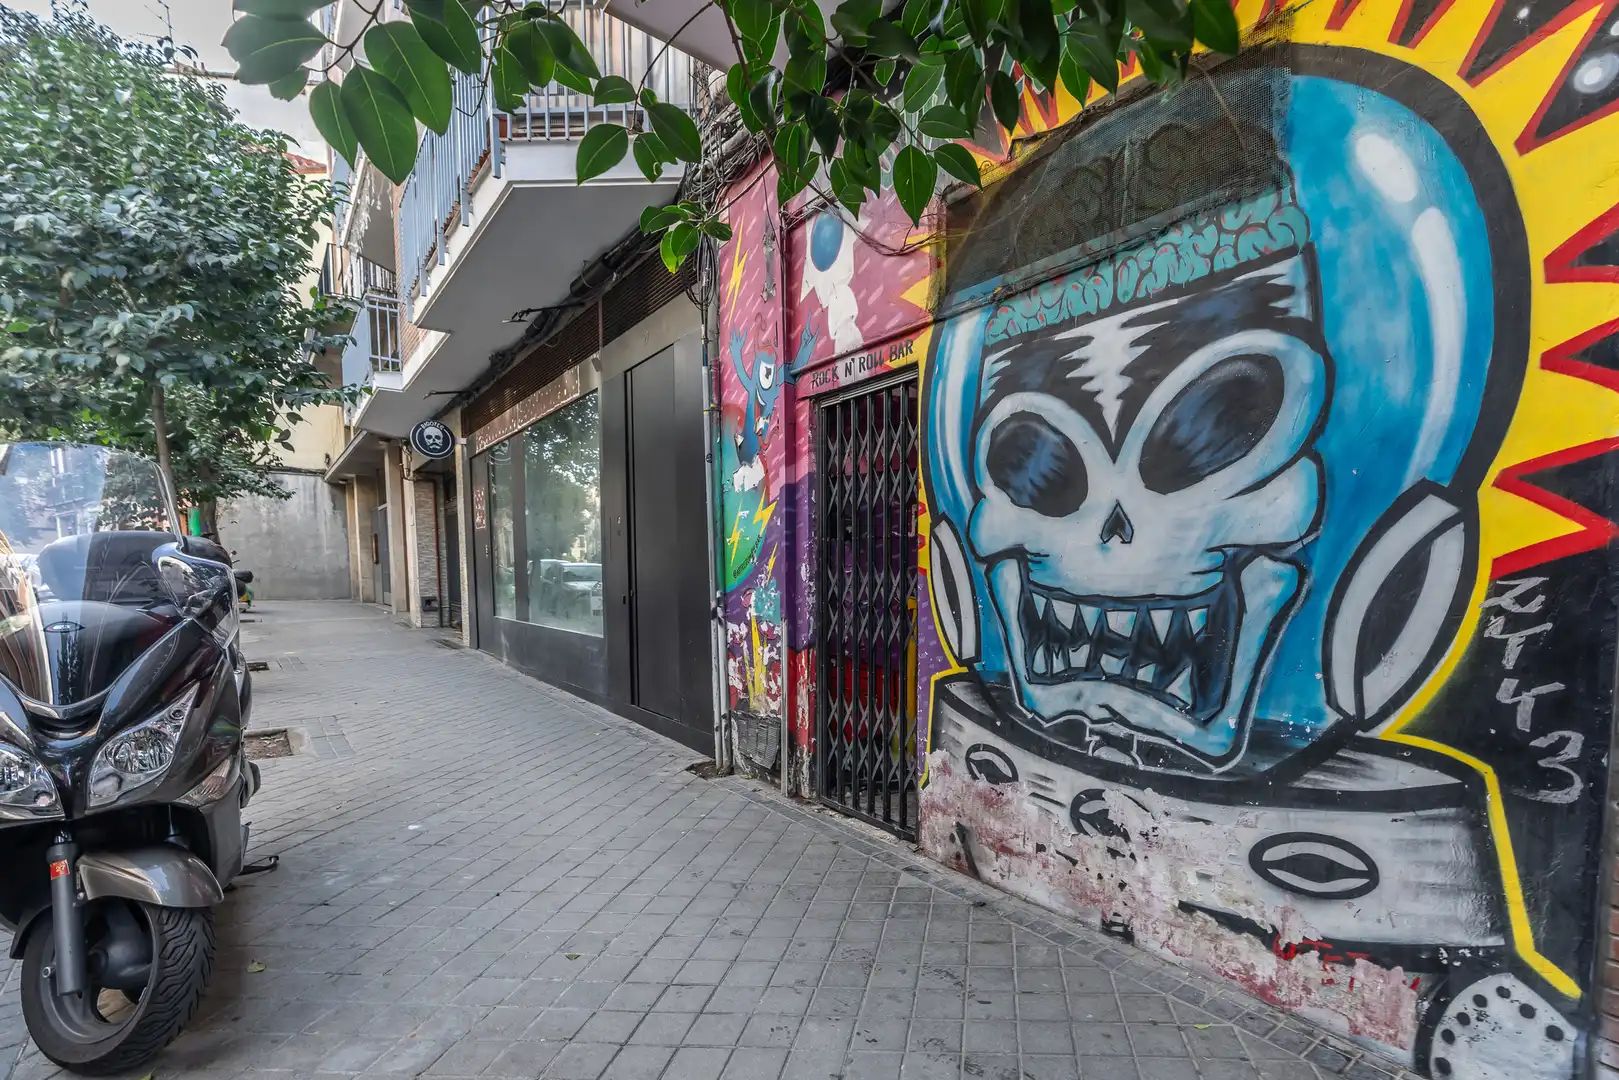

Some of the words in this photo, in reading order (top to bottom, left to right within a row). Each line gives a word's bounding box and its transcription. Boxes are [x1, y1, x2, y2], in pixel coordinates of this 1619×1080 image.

[811, 365, 840, 389] ROCK
[844, 357, 855, 378] N'
[859, 353, 884, 373] ROLL
[889, 338, 913, 361] BAR
